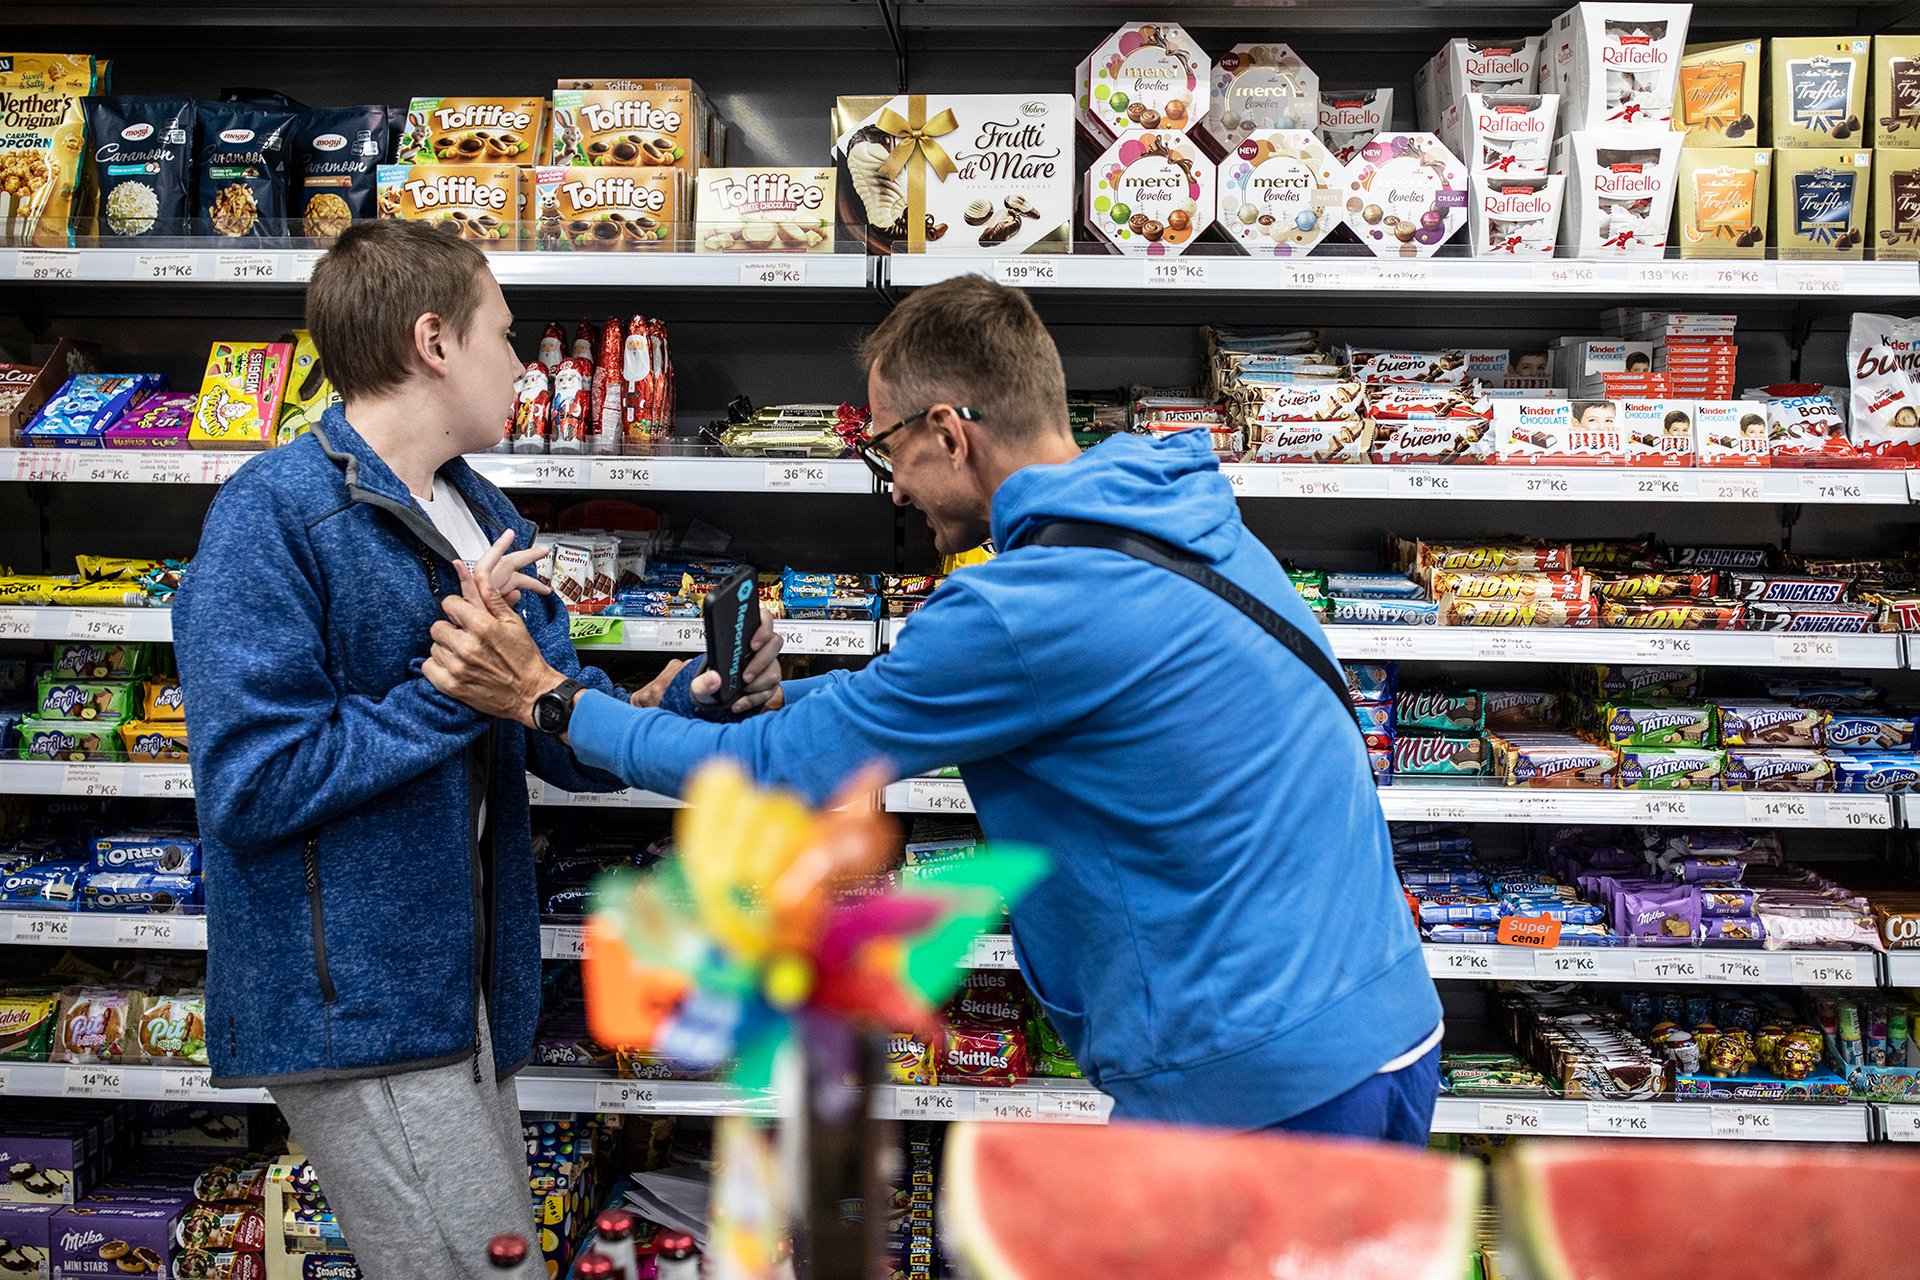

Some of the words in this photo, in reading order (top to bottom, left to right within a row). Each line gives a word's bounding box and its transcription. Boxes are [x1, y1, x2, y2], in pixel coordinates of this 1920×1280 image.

[1222, 58, 1239, 66] NEW
[1602, 47, 1668, 64] Raffaello
[1125, 64, 1178, 79] merci
[1466, 58, 1529, 76] Raffaello
[1133, 78, 1169, 93] lovelies
[1236, 83, 1288, 98] merci
[1795, 79, 1847, 109] Truffles
[1244, 95, 1279, 110] lovelies
[1687, 83, 1737, 110] Truffles
[5, 109, 65, 130] Original
[435, 105, 532, 130] Toffifee
[581, 101, 682, 132] Toffifee
[1318, 110, 1380, 126] Raffaello
[1479, 115, 1545, 133] Raffaello
[125, 126, 150, 137] mogyi
[223, 132, 251, 142] mogyi
[974, 117, 1046, 152] Frutti
[316, 137, 343, 148] mogyi
[1239, 147, 1258, 155] NEW
[1362, 148, 1381, 157] NEW
[977, 148, 1061, 181] Mare
[1125, 173, 1181, 189] merci
[1253, 173, 1309, 189] merci
[1594, 175, 1661, 192] Raffaello
[405, 176, 507, 208] Toffifee
[562, 179, 666, 211] Toffifee
[710, 174, 824, 210] Toffifee
[1135, 188, 1172, 204] lovelies
[1262, 188, 1300, 204] lovelies
[1388, 189, 1425, 204] lovelies
[1437, 195, 1465, 203] CREAMY
[738, 201, 759, 212] WHITE
[760, 200, 797, 211] CHOCOLATE
[1484, 196, 1552, 213] Raffaello
[1799, 191, 1850, 220] Truffles
[1588, 353, 1624, 361] CHOCOLATE
[1589, 345, 1616, 354] Kinder
[245, 352, 263, 394] WEDGIES
[1376, 356, 1426, 373] bueno
[1278, 394, 1321, 407] bueno
[1625, 402, 1652, 411] Kinder
[1519, 405, 1554, 416] Kinder
[1624, 411, 1662, 420] CHOCOLATE
[1699, 406, 1726, 415] Kinder
[1797, 405, 1836, 417] Bons
[1519, 415, 1568, 425] CHOCOLATE
[1277, 432, 1323, 448] bueno
[1400, 432, 1451, 449] bueno
[1447, 546, 1507, 569] LION
[1547, 548, 1558, 561] 2
[1697, 549, 1762, 566] SNICKERS
[902, 576, 926, 587] CANDY
[906, 582, 927, 593] NUT
[1460, 573, 1521, 598] LION
[1602, 574, 1664, 597] LION
[1744, 581, 1766, 600] 2
[1766, 583, 1840, 601] SNICKERS
[1476, 603, 1538, 626] LION
[1579, 604, 1591, 618] 2
[1624, 607, 1690, 629] LION
[1769, 614, 1791, 631] 2
[1790, 615, 1865, 632] SNICKERS
[57, 648, 101, 670] Marilky
[1630, 671, 1683, 690] TATRANKY
[43, 688, 89, 711] Marilky
[1396, 692, 1460, 722] Mila
[1489, 695, 1540, 712] TATRANKY
[1609, 723, 1637, 733] OPAVIA
[1639, 715, 1697, 733] TATRANKY
[1747, 711, 1803, 731] TATRANKY
[1835, 722, 1879, 741] Delissa
[29, 734, 76, 755] Marilky
[133, 737, 173, 755] Marilky
[1394, 735, 1464, 771] Mila
[1539, 755, 1598, 777] TATRANKY
[1647, 760, 1705, 780] TATRANKY
[1752, 762, 1811, 781] TATRANKY
[1870, 770, 1916, 788] Delissa
[108, 846, 164, 865] OREO
[96, 892, 154, 907] OREO
[1637, 910, 1669, 925] Milka
[1509, 920, 1553, 935] Super
[1772, 917, 1854, 940] CORNY
[1511, 935, 1545, 945] cena!
[960, 1000, 1019, 1020] Skittles
[70, 1013, 104, 1045] Pit
[147, 1017, 187, 1047] Pit
[158, 1038, 182, 1050] apple
[537, 1044, 576, 1063] Papita
[947, 1049, 1009, 1070] Skittles
[631, 1061, 673, 1079] Papita
[1453, 1070, 1488, 1078] Alaska
[60, 1230, 105, 1251] Milka
[64, 1260, 82, 1272] MINI
[83, 1260, 108, 1273] STARS
[315, 1265, 357, 1279] SMARTIES
